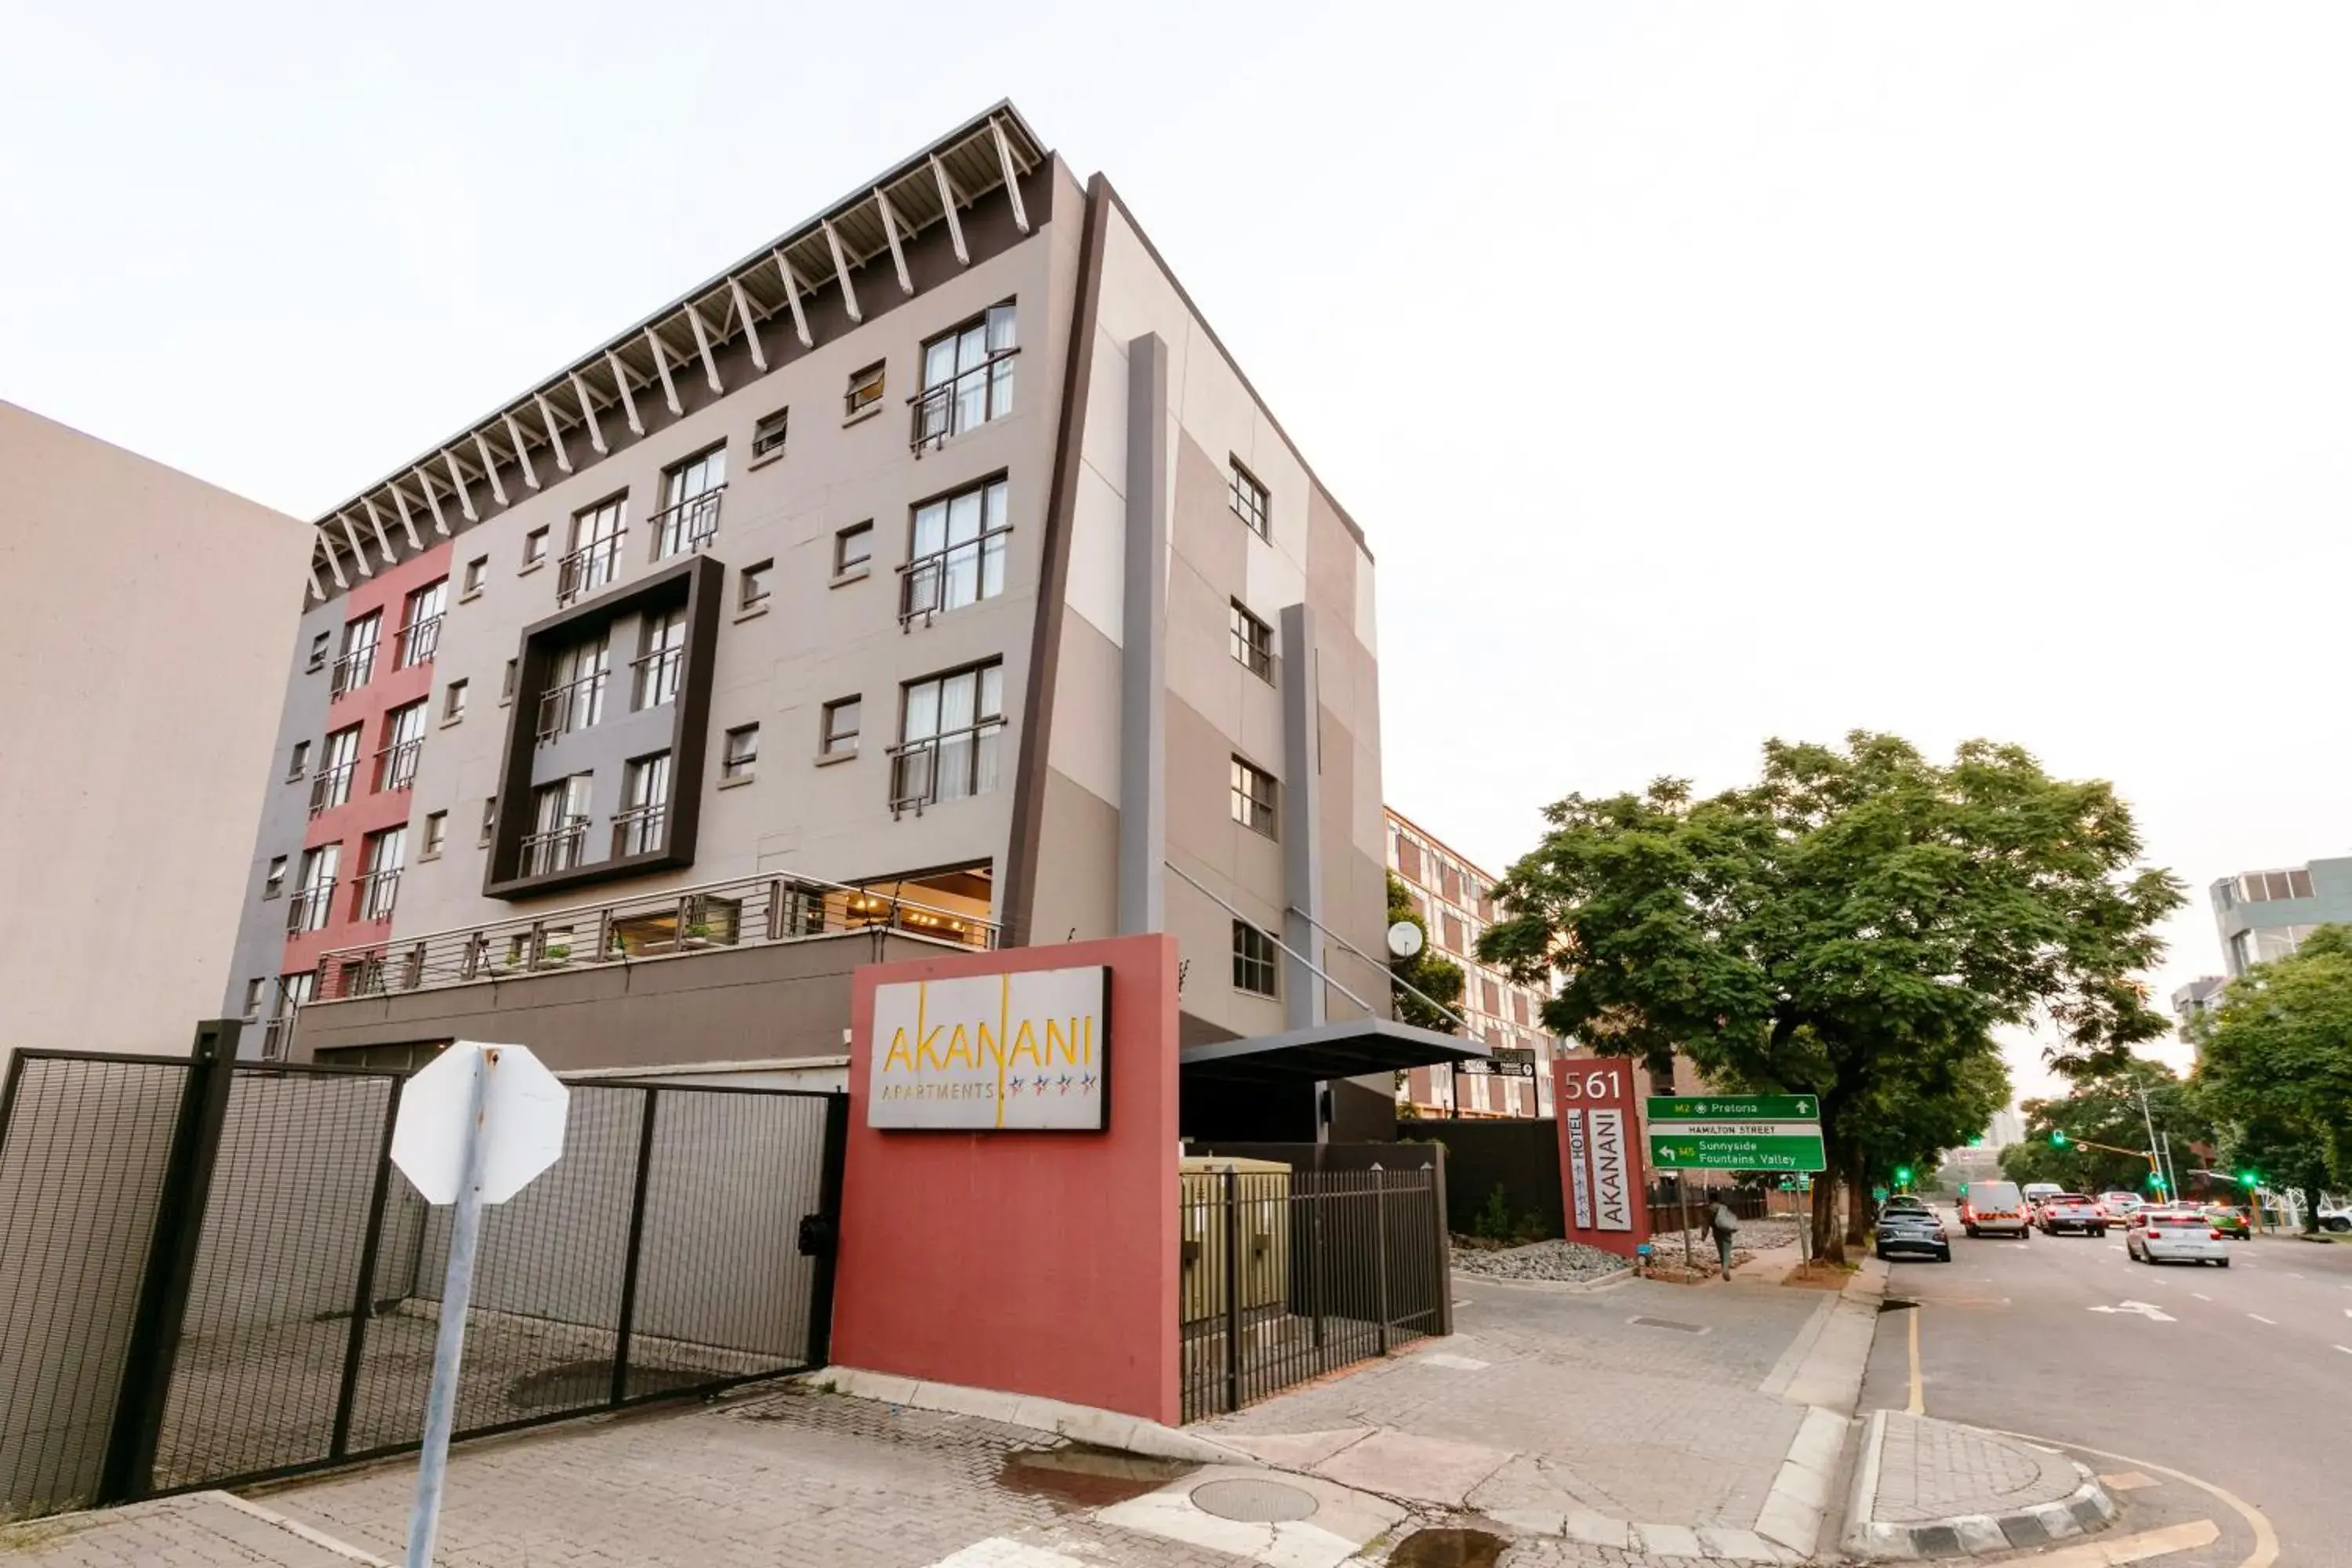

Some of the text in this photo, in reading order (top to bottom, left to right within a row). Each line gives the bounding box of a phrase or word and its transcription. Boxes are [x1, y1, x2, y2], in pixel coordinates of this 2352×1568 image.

[882, 1082, 994, 1100] APARTMENTS
[1566, 1070, 1621, 1099] 561
[1711, 1103, 1758, 1113] Pretoria
[1569, 1112, 1584, 1159] HOTEL
[1688, 1125, 1776, 1134] HAMILTON STREET
[1699, 1141, 1757, 1153] Sunnyside
[1699, 1153, 1797, 1167] Fountains Valley
[1595, 1114, 1624, 1223] AKANANI
